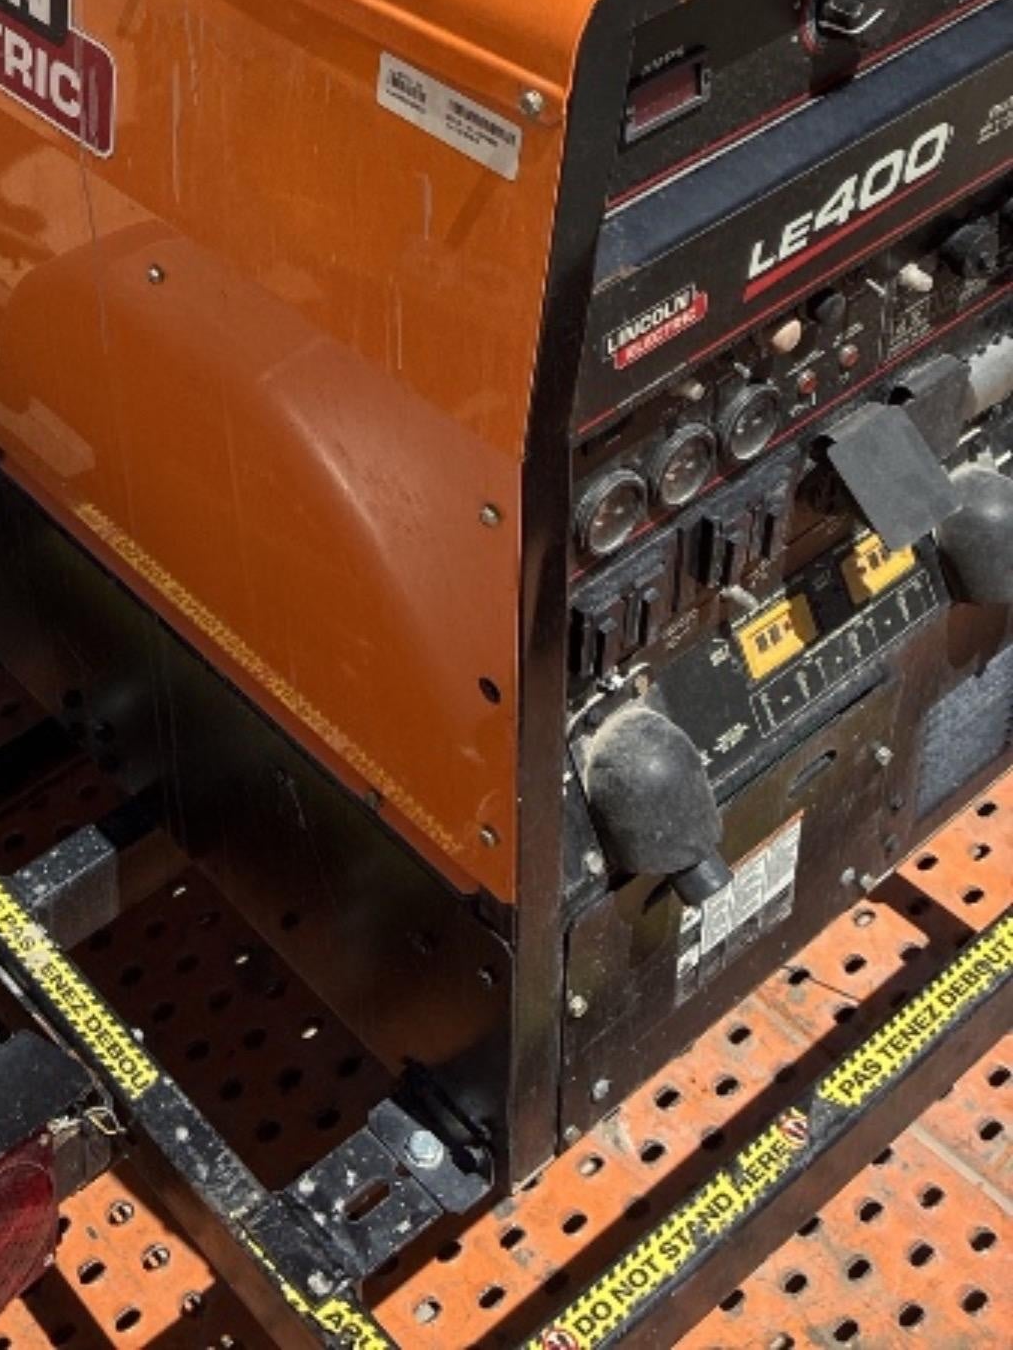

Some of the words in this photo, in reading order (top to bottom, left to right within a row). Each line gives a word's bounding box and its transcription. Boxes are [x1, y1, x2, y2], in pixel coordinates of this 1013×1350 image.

[748, 122, 950, 280] LE400
[606, 292, 690, 355] LINCOLN
[38, 958, 89, 1017] ENEZ
[572, 1301, 613, 1337] DO
[613, 1256, 664, 1303] NOT
[658, 1191, 734, 1261] STAND
[838, 1058, 883, 1098] PAS
[875, 1003, 938, 1060] TENEZ
[937, 936, 1010, 1009] DEBOUT
